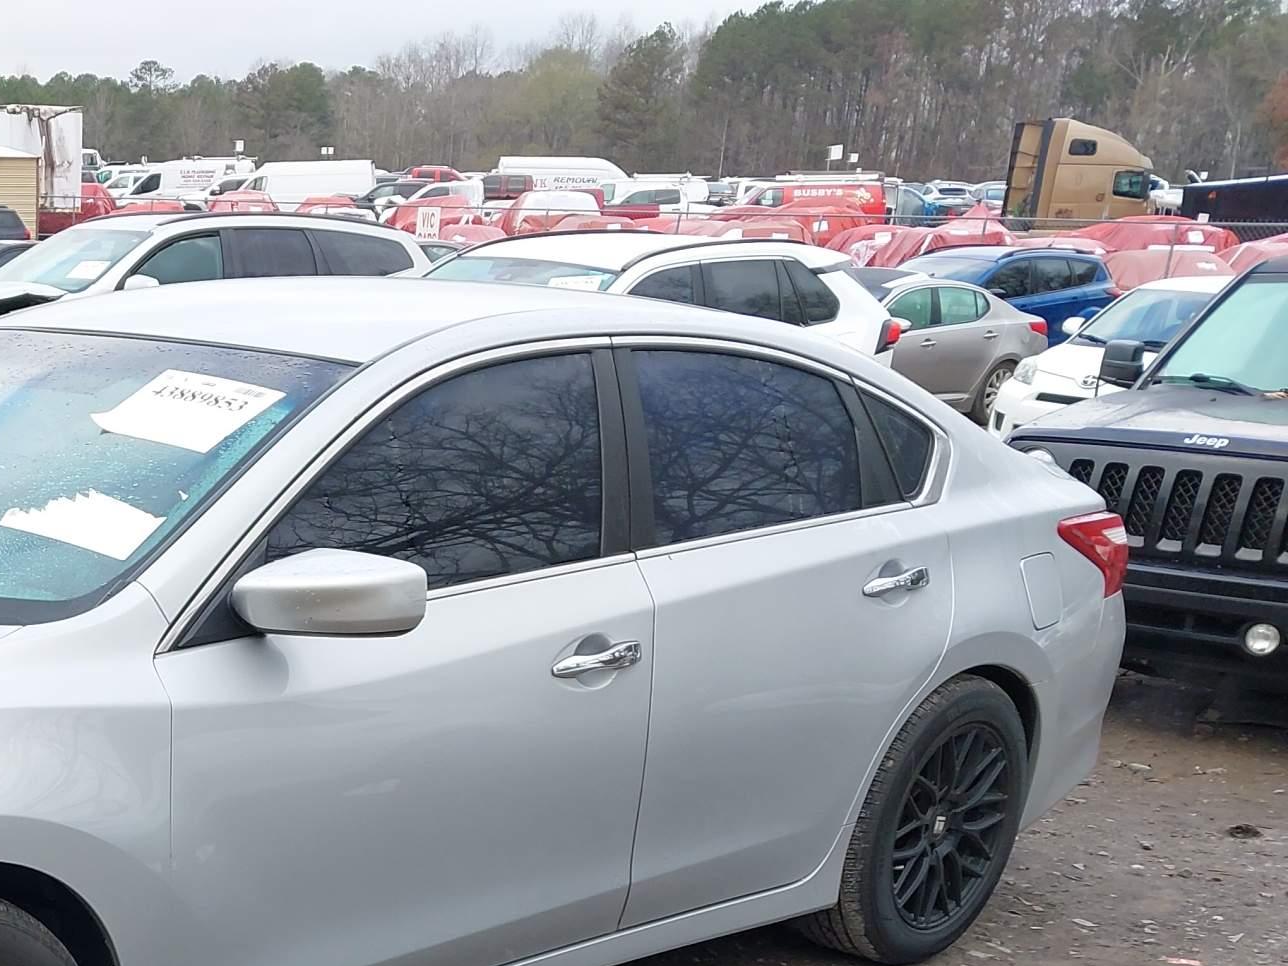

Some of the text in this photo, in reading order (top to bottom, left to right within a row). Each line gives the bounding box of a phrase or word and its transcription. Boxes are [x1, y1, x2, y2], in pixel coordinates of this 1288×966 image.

[793, 188, 844, 197] BUSBY'S
[152, 384, 249, 412] 43889853
[1184, 434, 1230, 449] Jeep
